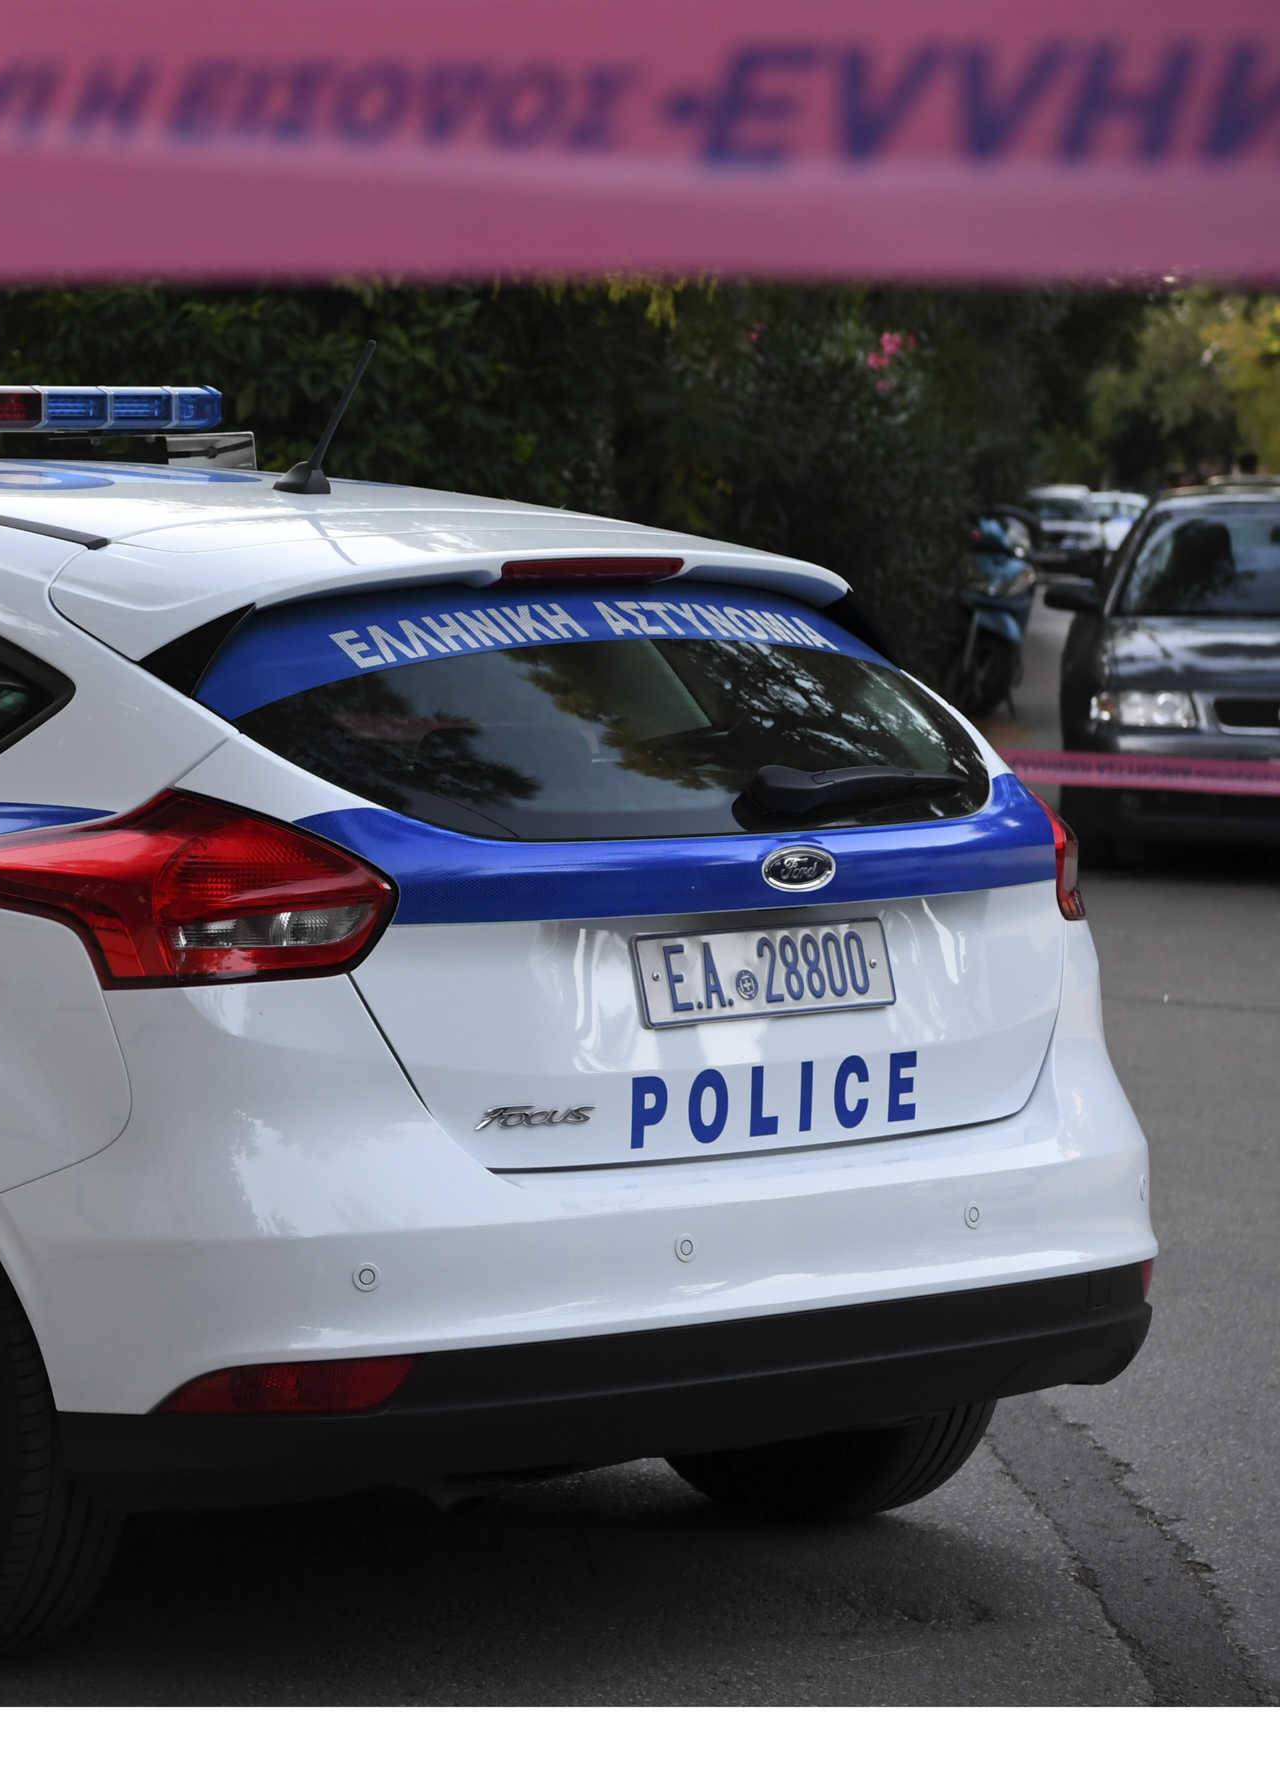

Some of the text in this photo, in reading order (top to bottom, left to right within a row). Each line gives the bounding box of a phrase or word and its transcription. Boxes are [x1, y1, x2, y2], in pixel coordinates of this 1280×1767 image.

[329, 600, 840, 669] ΕΛΛΗΝΙΚΗ ΑΣΤΥΝΟΜΙΑ
[780, 857, 819, 880] Ford
[756, 930, 871, 1004] 28800
[630, 1050, 918, 1149] POLICE
